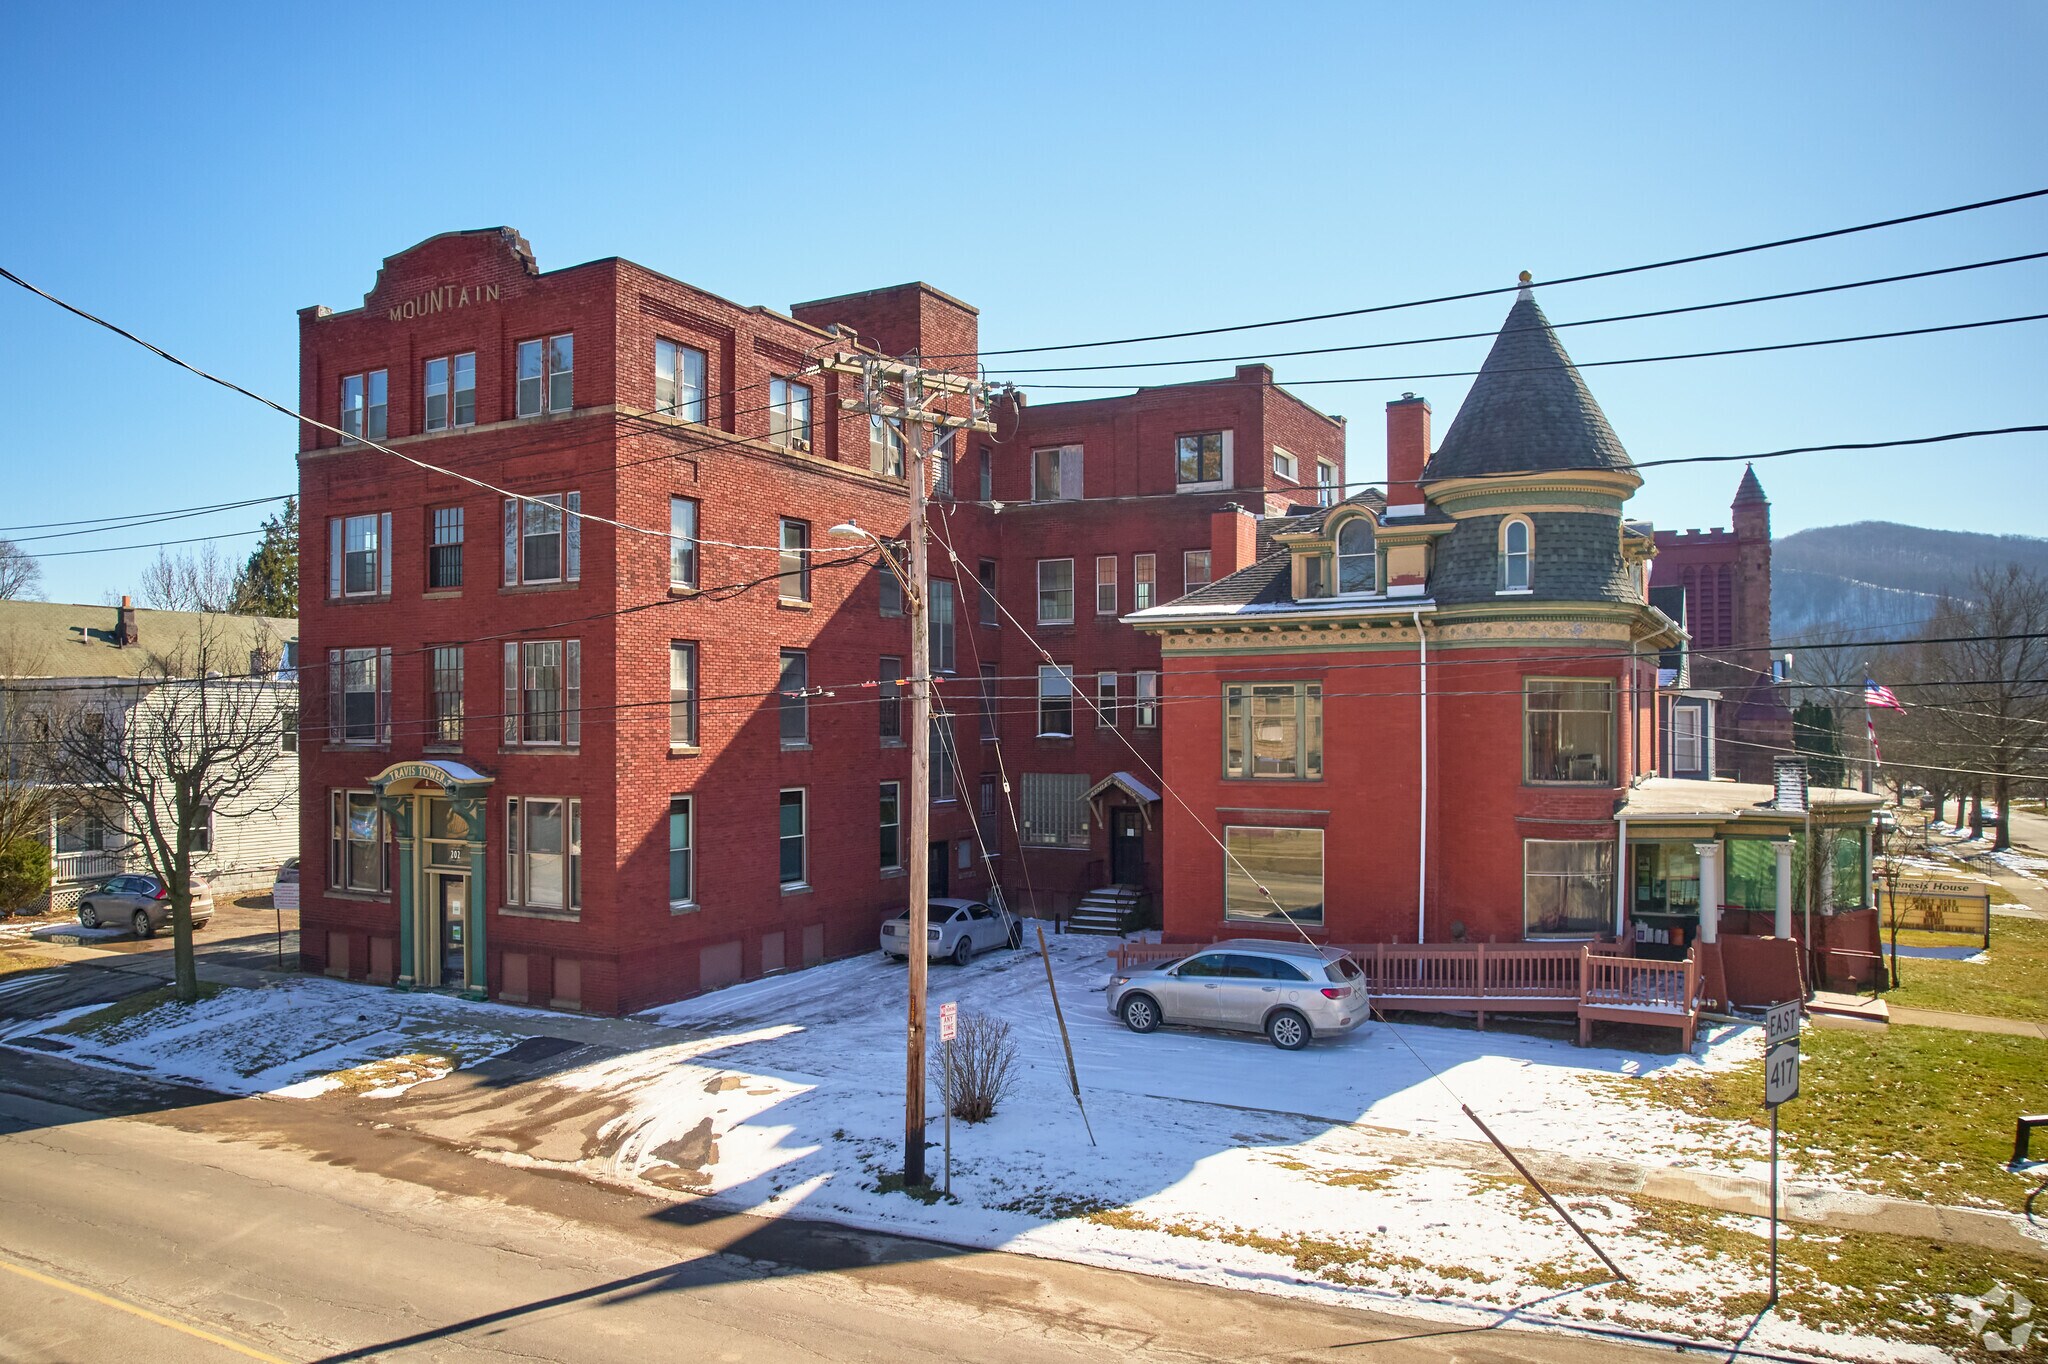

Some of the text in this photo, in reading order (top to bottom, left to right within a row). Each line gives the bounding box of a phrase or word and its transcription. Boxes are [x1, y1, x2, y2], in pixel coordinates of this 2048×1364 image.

[389, 284, 500, 321] MOUNTAIN
[389, 766, 416, 781] TRAVIS
[450, 850, 461, 859] 202
[1933, 882, 1970, 892] House
[943, 1023, 954, 1032] TIME
[1770, 1009, 1796, 1037] EAST
[1770, 1057, 1795, 1089] 417
